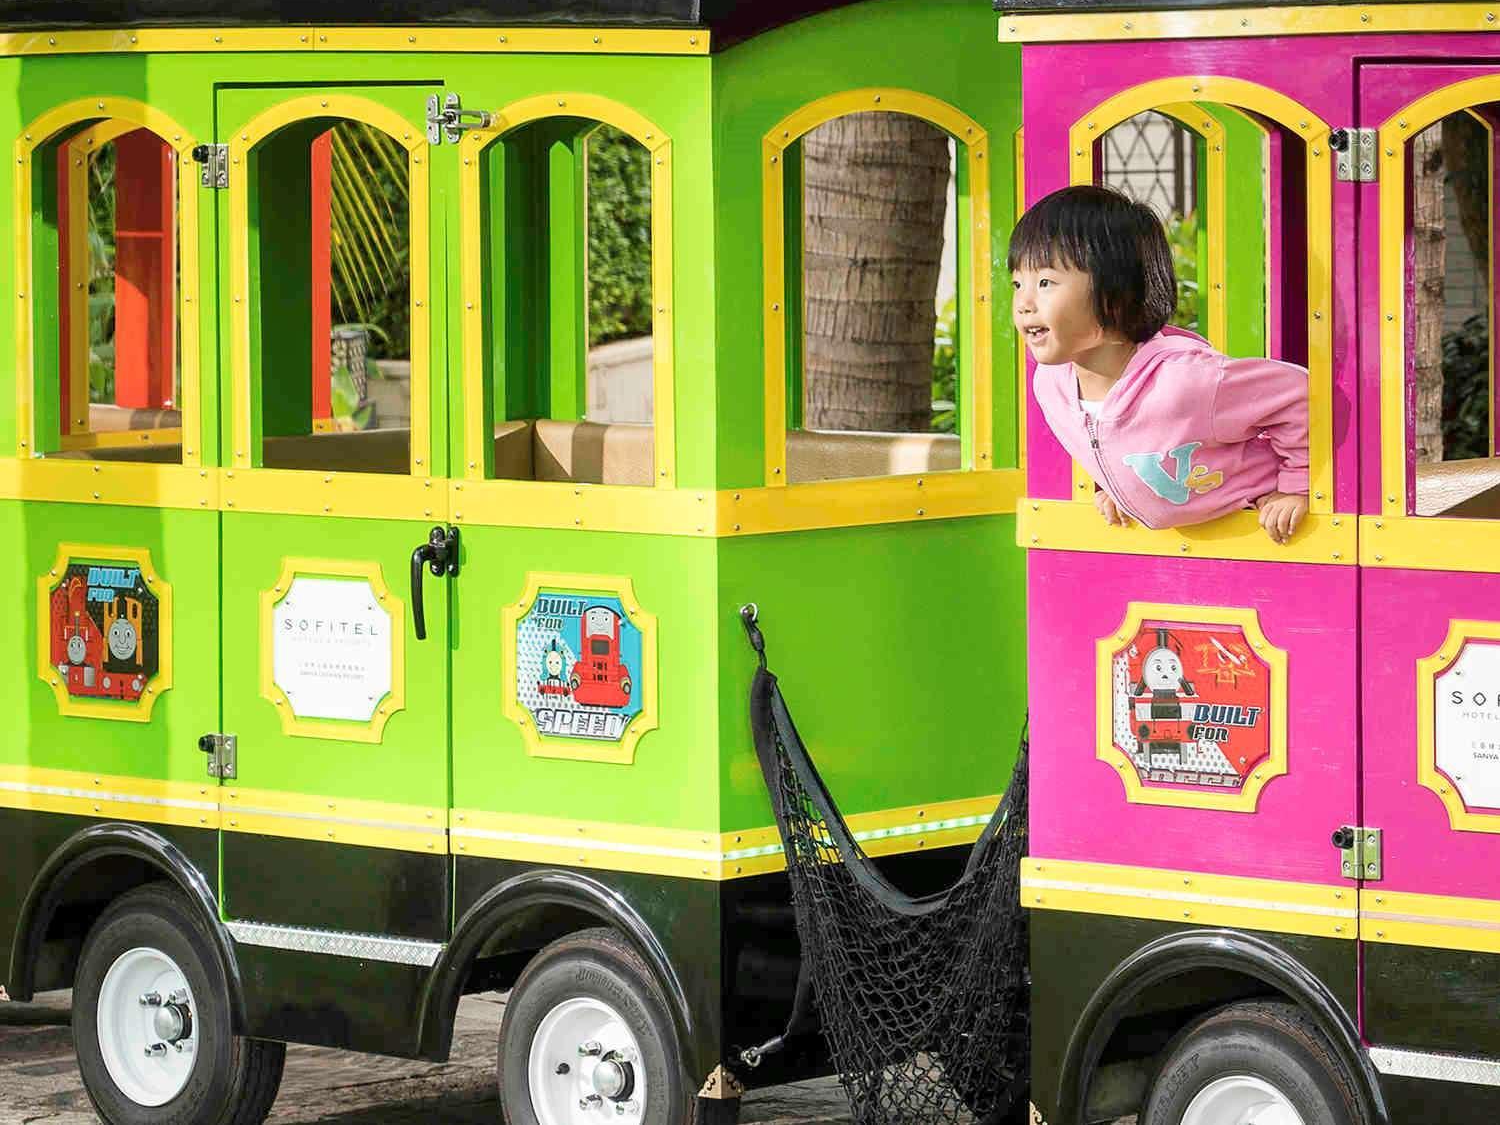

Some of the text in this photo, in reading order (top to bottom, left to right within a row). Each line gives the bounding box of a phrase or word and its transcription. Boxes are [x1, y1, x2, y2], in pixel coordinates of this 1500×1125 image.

[87, 567, 139, 588] BUILT
[87, 587, 115, 602] FOR
[537, 598, 587, 617] BUILT
[284, 618, 379, 636] SOFITEL
[537, 617, 564, 630] FOR
[536, 708, 627, 739] SPEED
[1193, 704, 1261, 727] BUILT
[1193, 726, 1229, 743] FOR
[1473, 751, 1499, 761] SANYA
